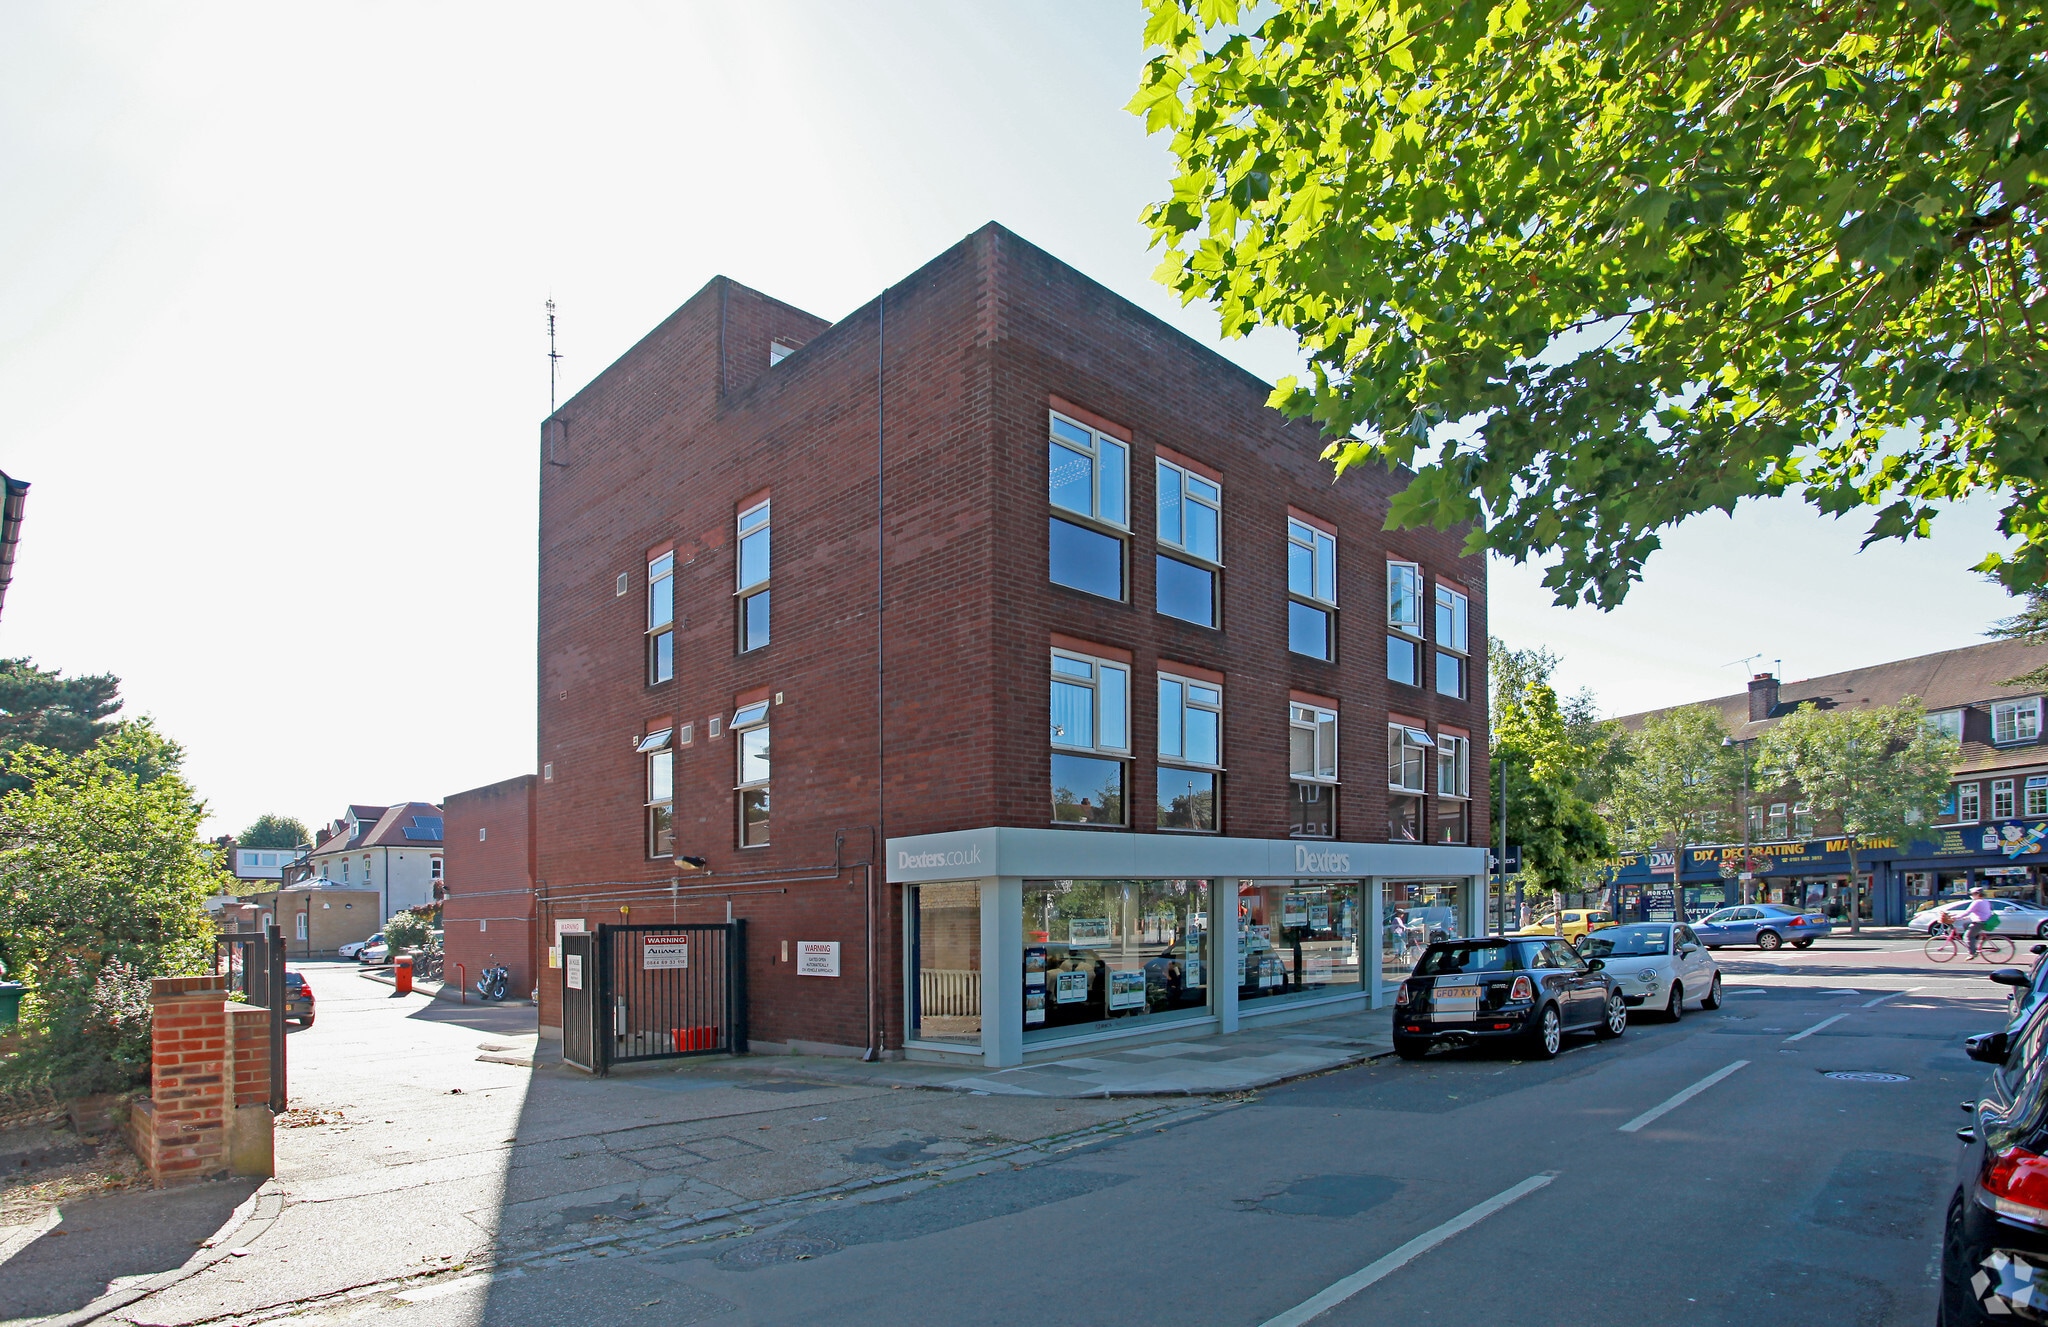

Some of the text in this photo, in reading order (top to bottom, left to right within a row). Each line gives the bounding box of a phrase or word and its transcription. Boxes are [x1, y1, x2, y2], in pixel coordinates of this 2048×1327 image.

[898, 842, 982, 870] Dexters.co.uk
[1294, 844, 1350, 873] Dexters
[1693, 849, 1719, 861] DIY,
[1721, 844, 1805, 859] DECORATING
[804, 944, 831, 952] WARNING
[1436, 988, 1478, 998] GF07 XYK
